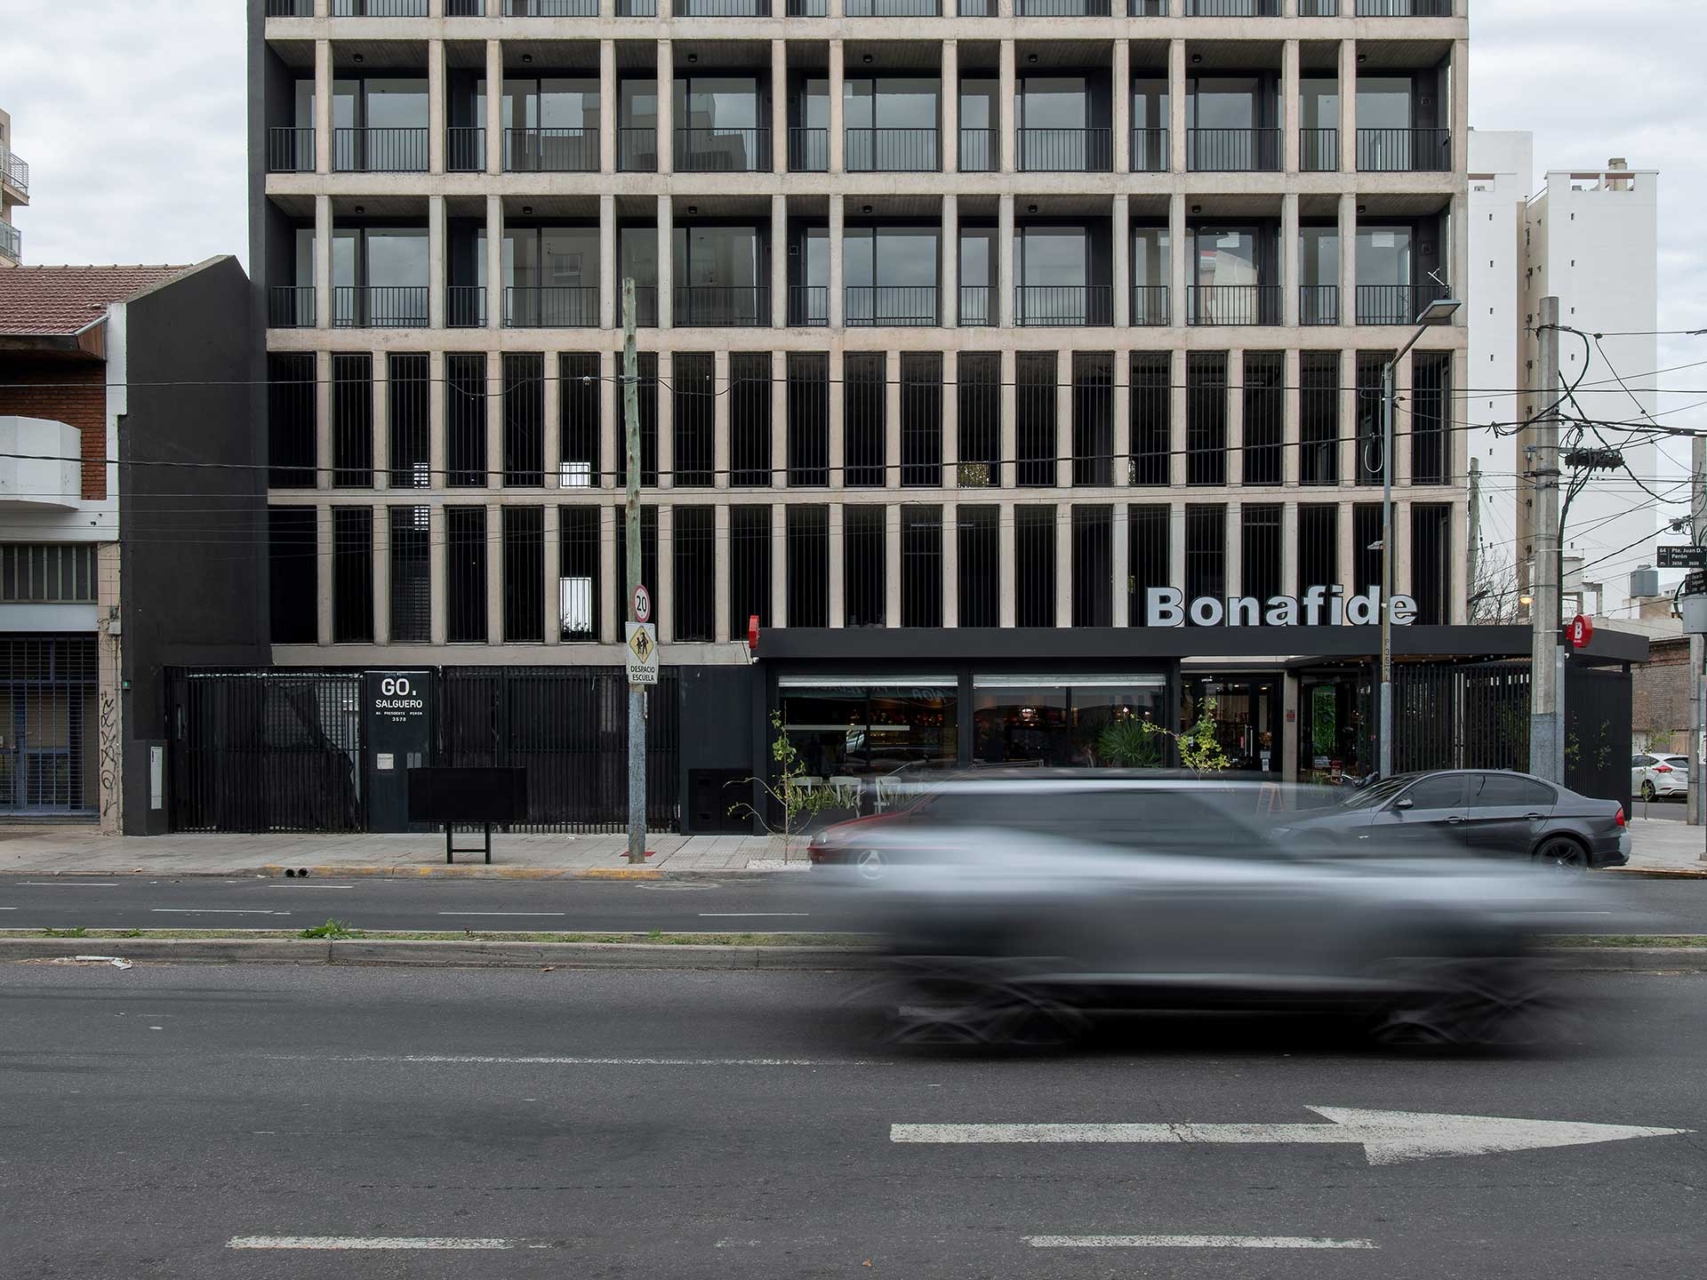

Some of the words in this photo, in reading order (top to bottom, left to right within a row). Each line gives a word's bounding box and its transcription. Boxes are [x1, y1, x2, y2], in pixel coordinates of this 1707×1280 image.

[636, 595, 647, 612] 20
[1147, 584, 1418, 626] Bonafide
[1574, 621, 1583, 639] B
[630, 665, 655, 674] DESPACIO
[632, 673, 655, 682] ESCUELA
[381, 677, 417, 696] GO.
[375, 699, 423, 709] SALGUERO
